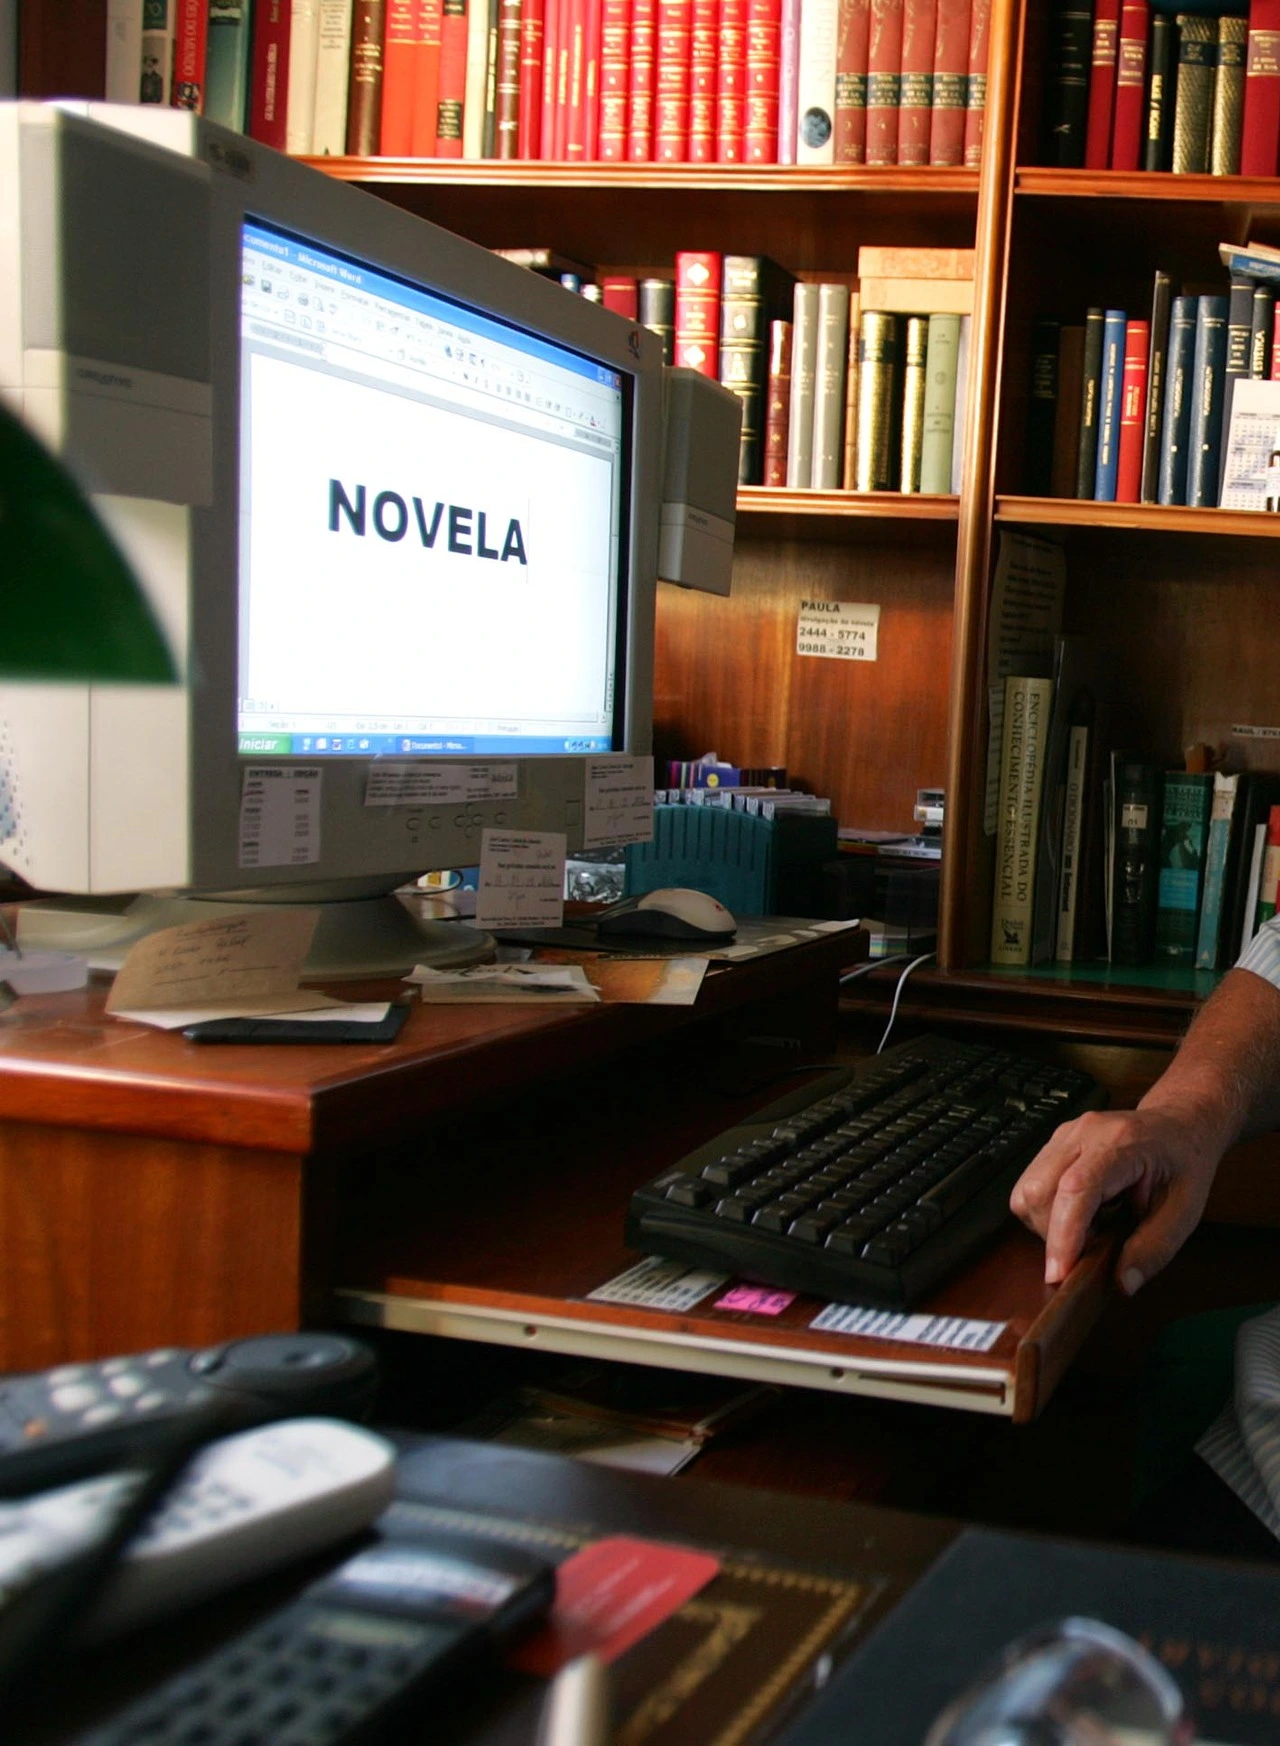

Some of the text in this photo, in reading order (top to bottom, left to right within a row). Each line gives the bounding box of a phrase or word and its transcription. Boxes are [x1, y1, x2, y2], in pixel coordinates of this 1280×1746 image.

[328, 478, 528, 566] NOVELA
[799, 627, 827, 638] 2444
[837, 629, 866, 641] 5774
[801, 601, 840, 613] PAULA
[239, 737, 278, 751] Iniciar
[1021, 692, 1040, 796] ENCICLOPÉDIA
[1000, 690, 1026, 899] CONHECIMENTO ESSENCIAL
[1018, 797, 1033, 876] ILUSTRADA
